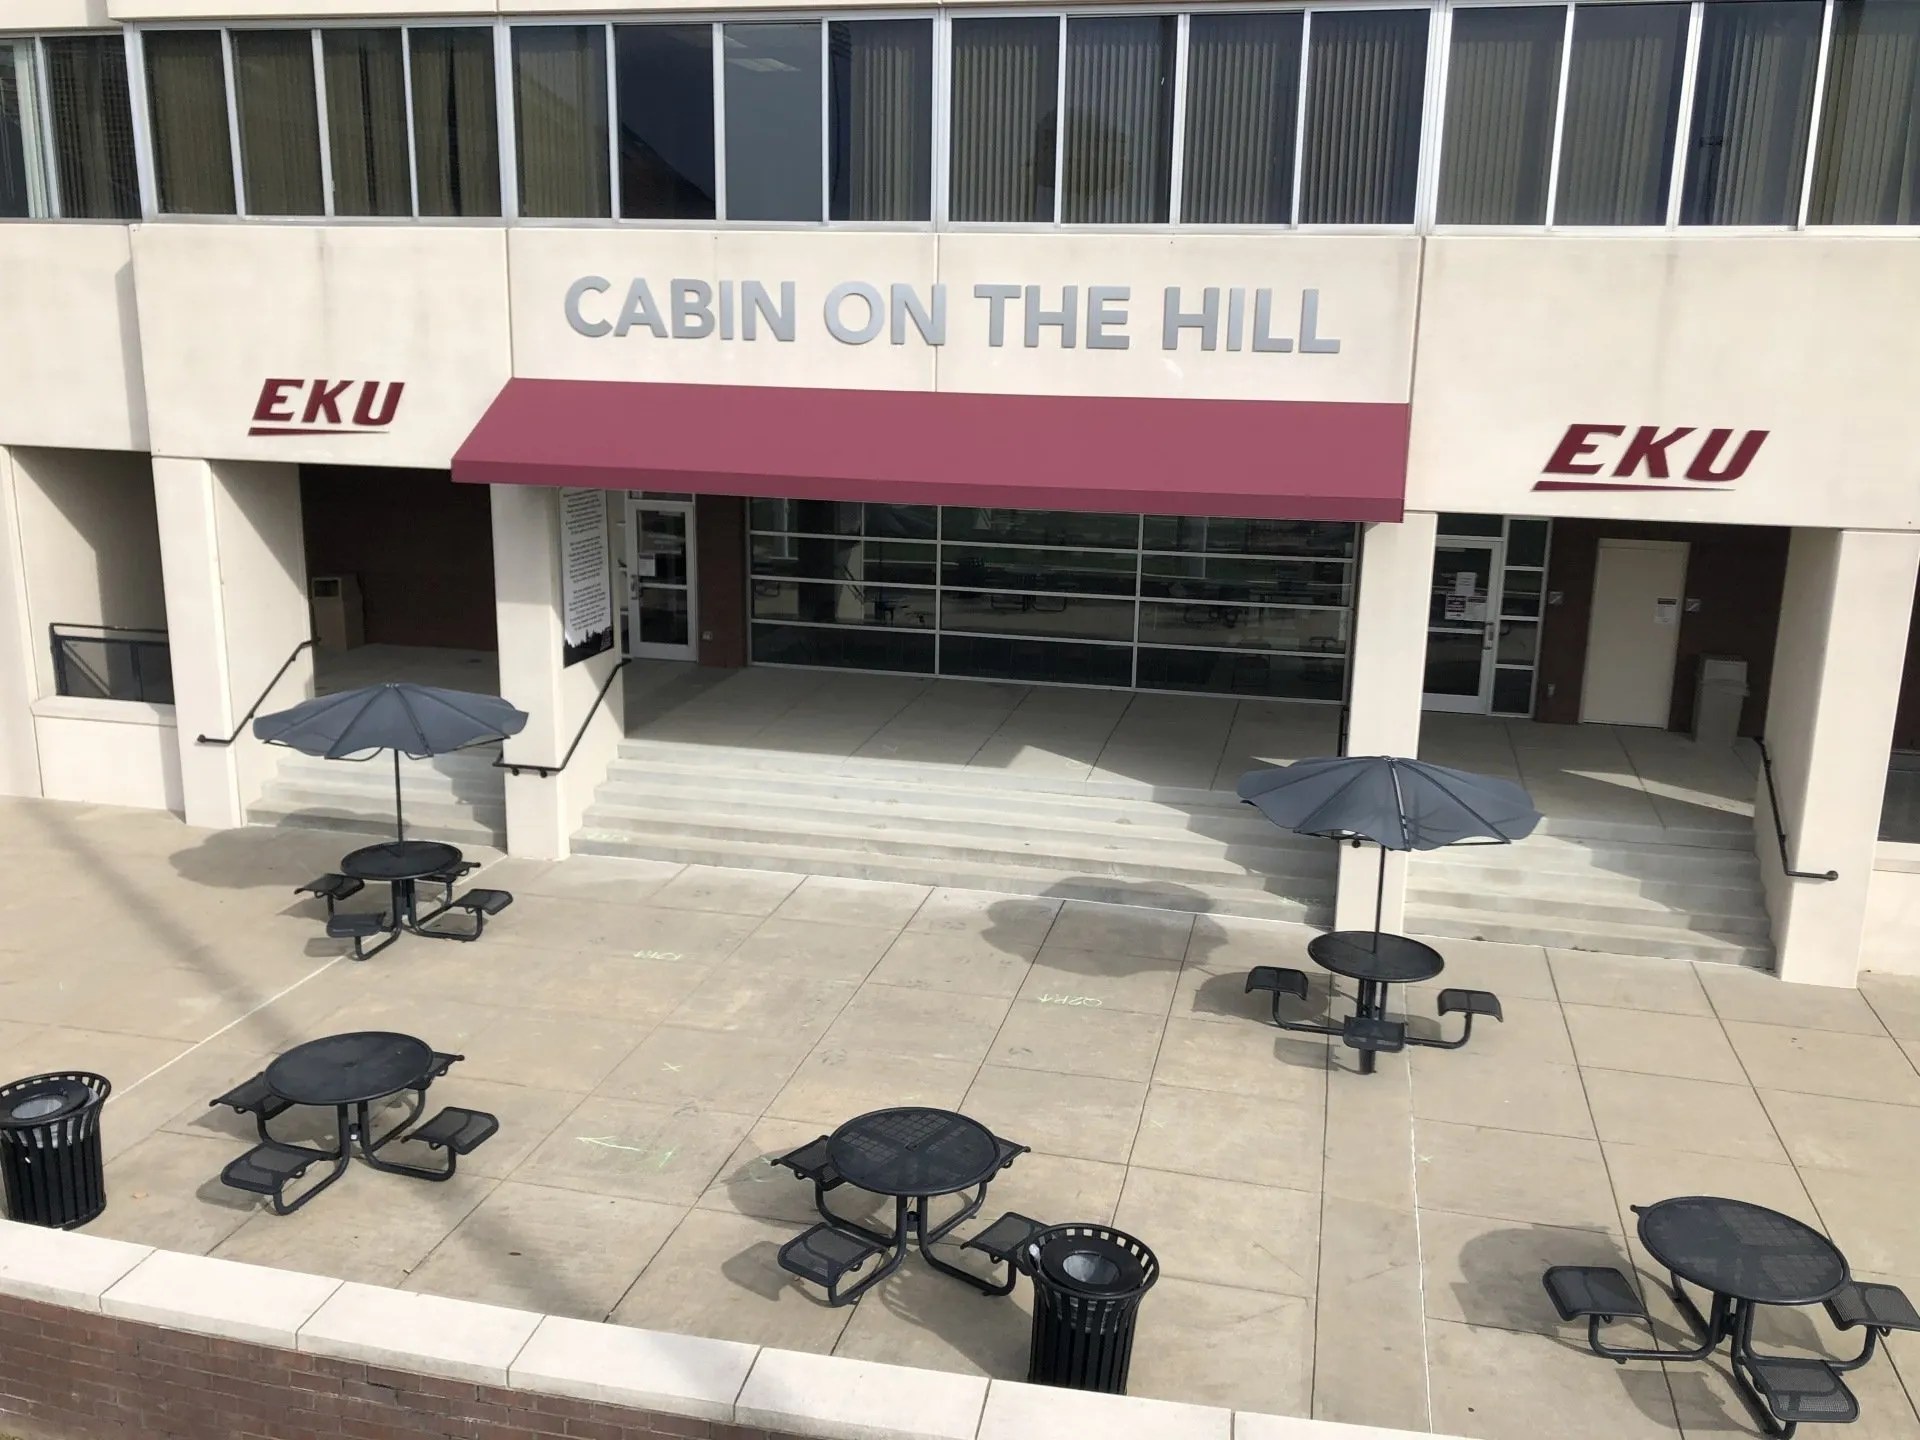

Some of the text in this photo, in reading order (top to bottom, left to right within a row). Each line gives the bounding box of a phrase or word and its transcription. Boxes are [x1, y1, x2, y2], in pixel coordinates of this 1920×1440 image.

[564, 276, 1341, 354] CABIN ON THE HILL
[252, 378, 405, 426] EKU
[1541, 423, 1770, 482] EKU
